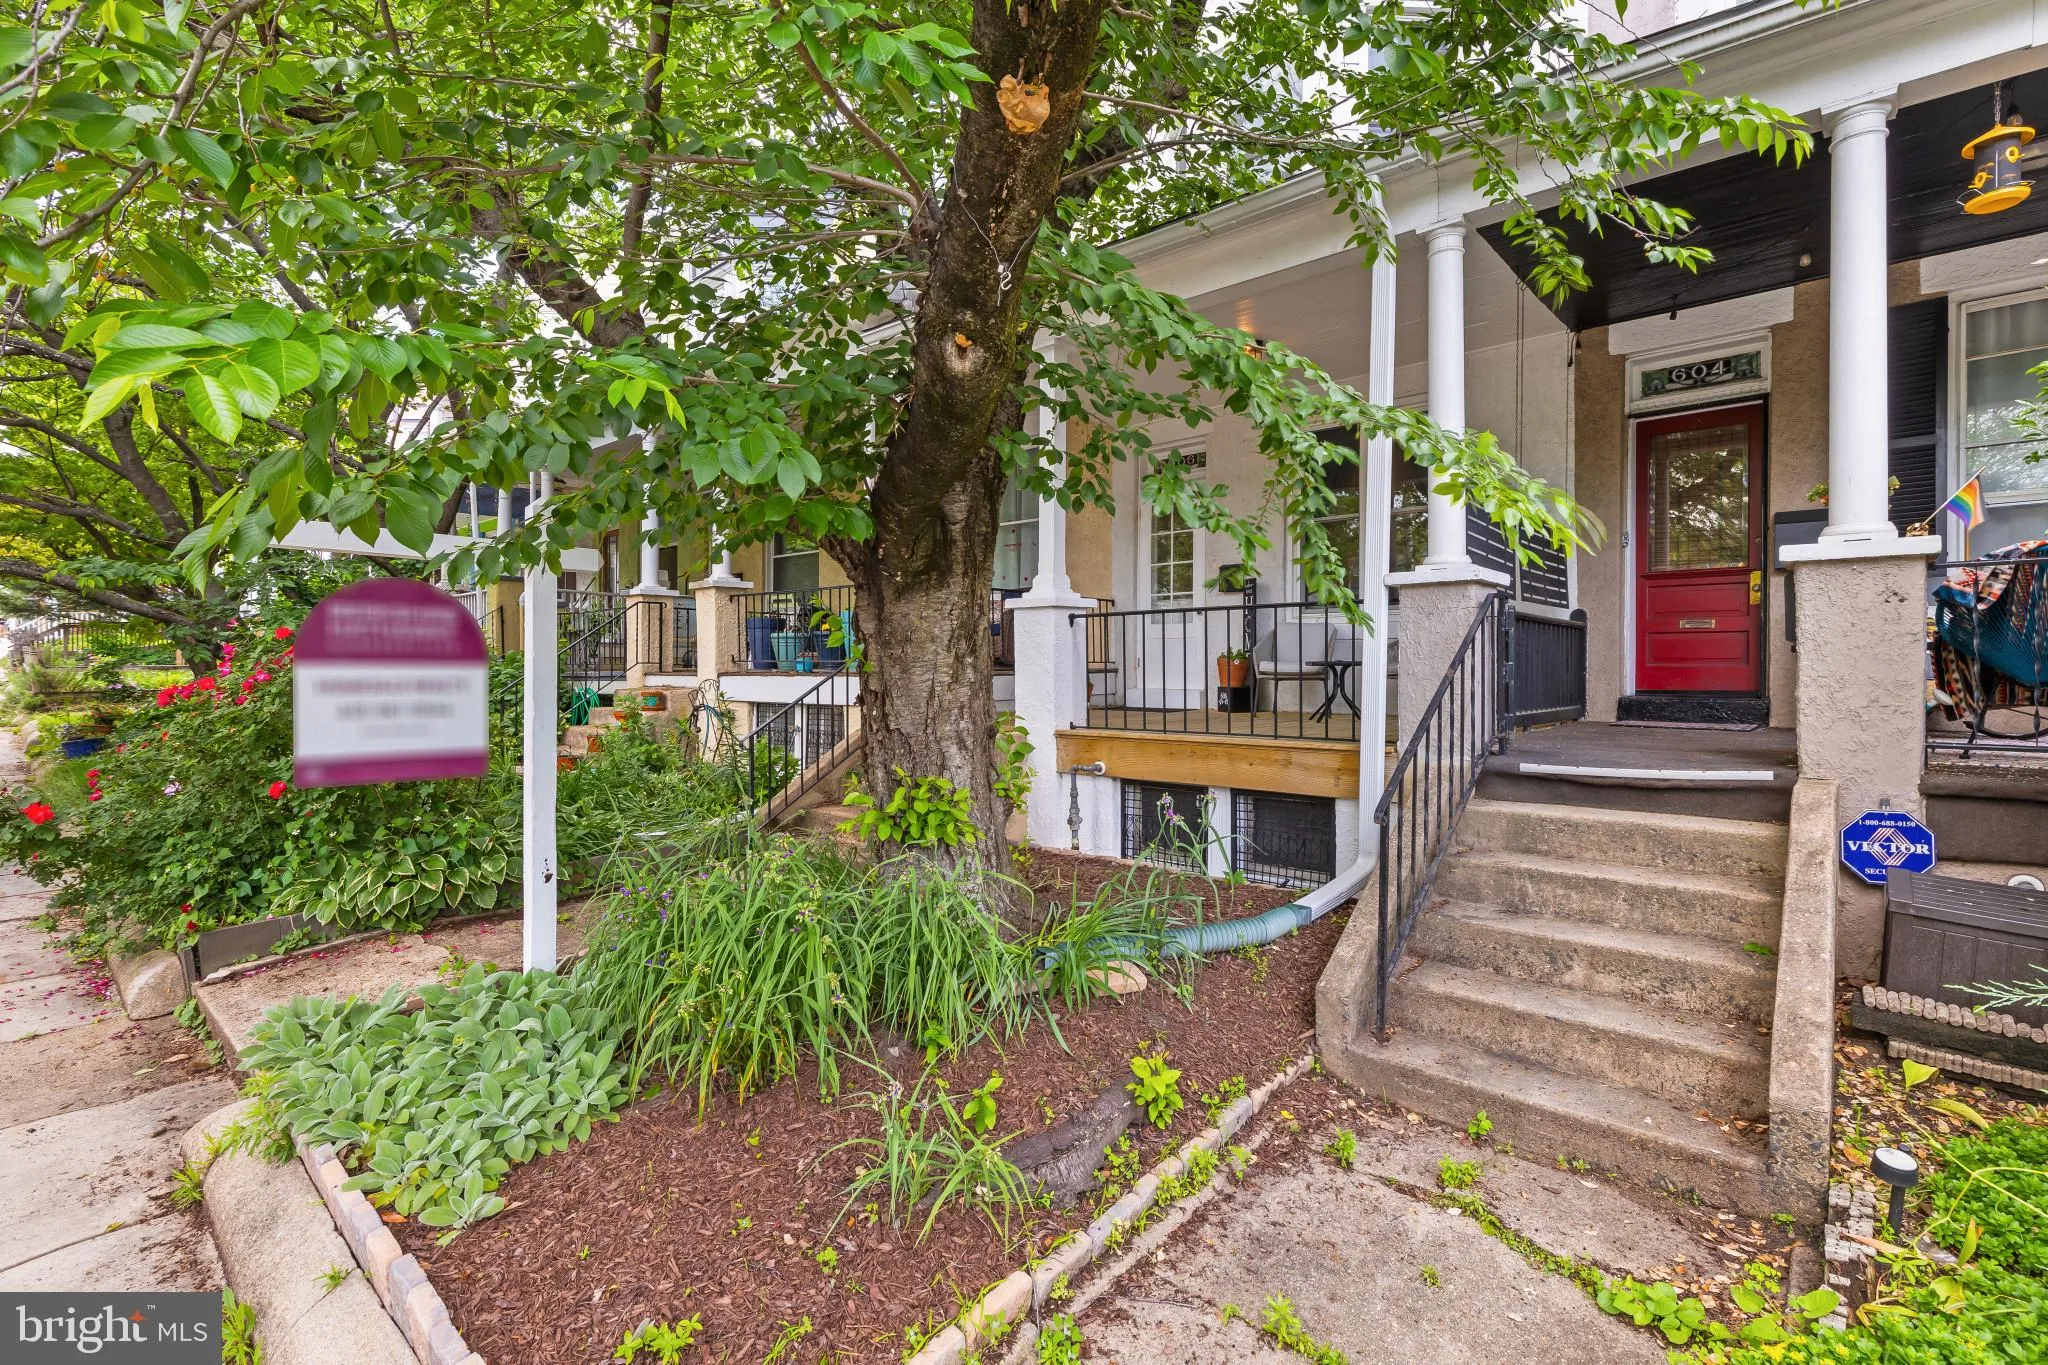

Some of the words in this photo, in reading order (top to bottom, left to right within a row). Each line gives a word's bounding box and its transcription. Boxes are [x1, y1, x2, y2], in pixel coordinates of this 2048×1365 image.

[1671, 360, 1727, 383] 604
[1858, 819, 1916, 828] 1-800-688-0150
[1846, 840, 1931, 855] VECTOR
